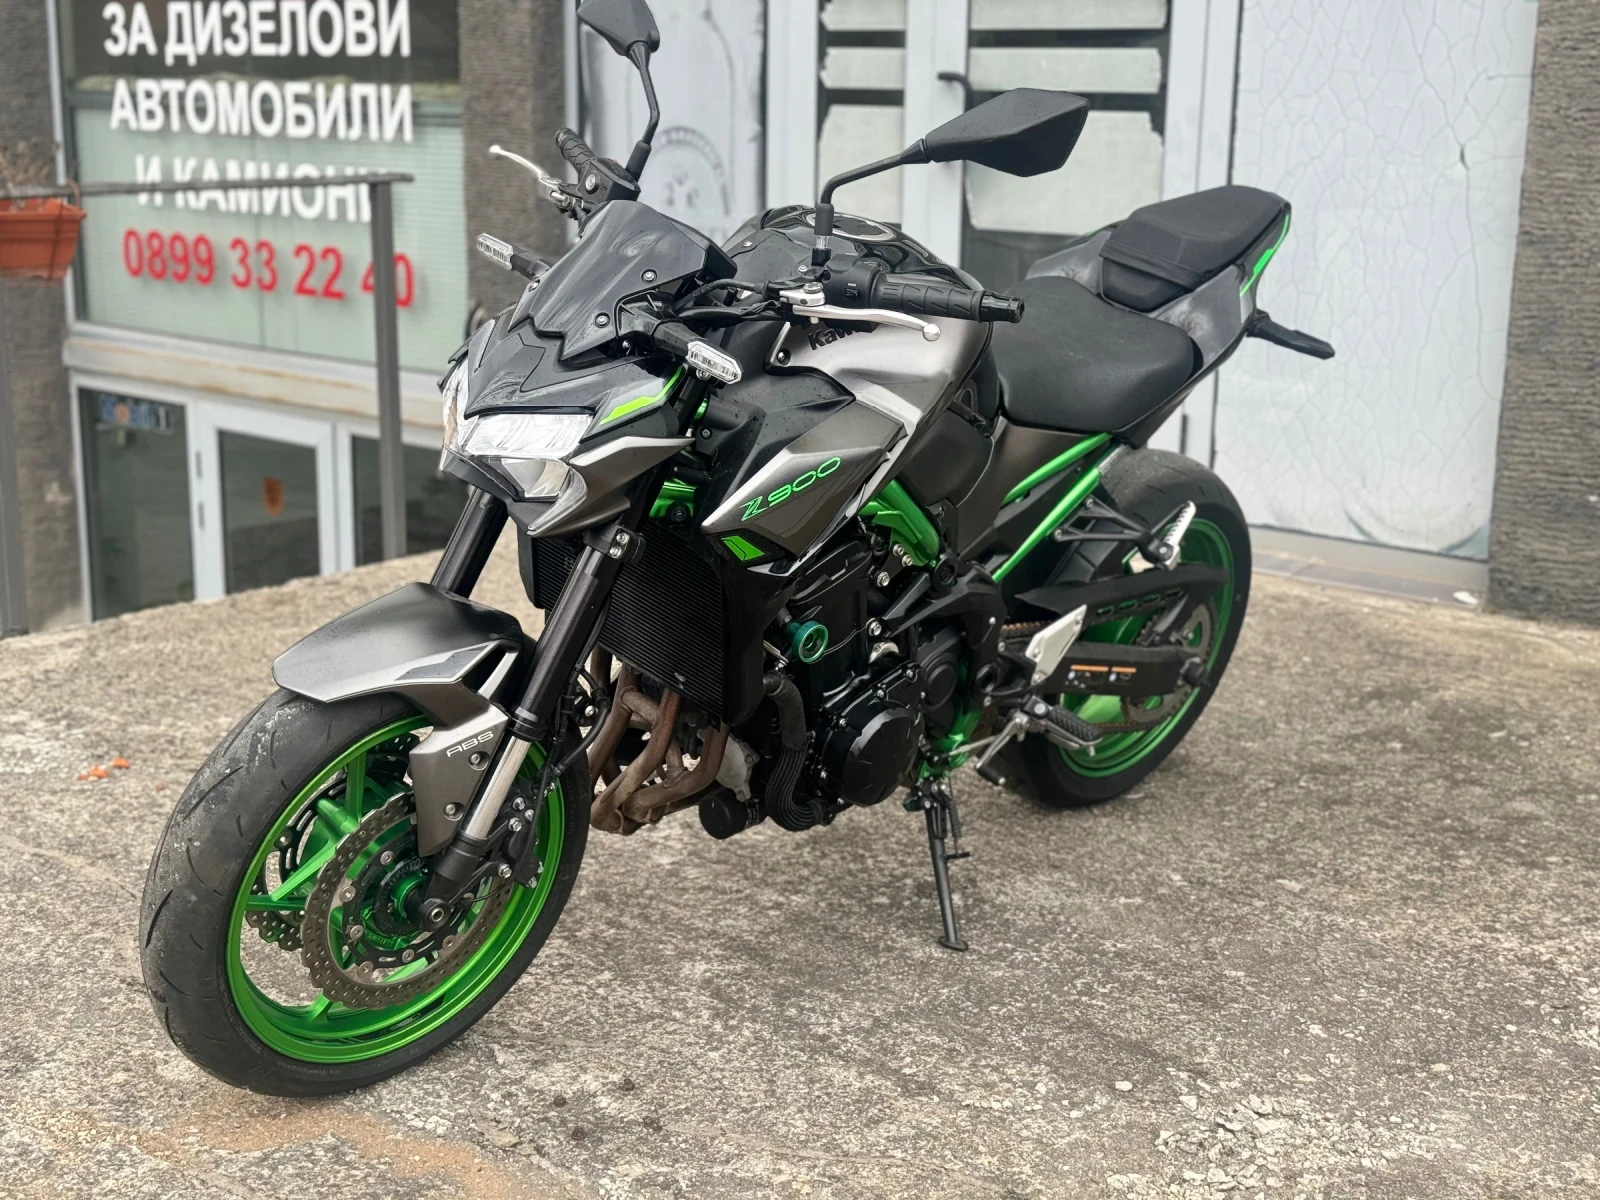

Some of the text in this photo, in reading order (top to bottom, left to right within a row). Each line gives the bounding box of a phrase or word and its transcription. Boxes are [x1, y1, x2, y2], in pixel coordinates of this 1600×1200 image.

[102, 0, 411, 66] ЗА ДИЗЕЛОВИ
[109, 78, 414, 143] АВТОМОБИЛИ
[134, 153, 163, 208] И
[123, 228, 216, 286] 0899
[230, 236, 279, 293] 33
[293, 243, 345, 300] 22
[739, 456, 841, 522] Z900
[446, 730, 494, 757] ABS
